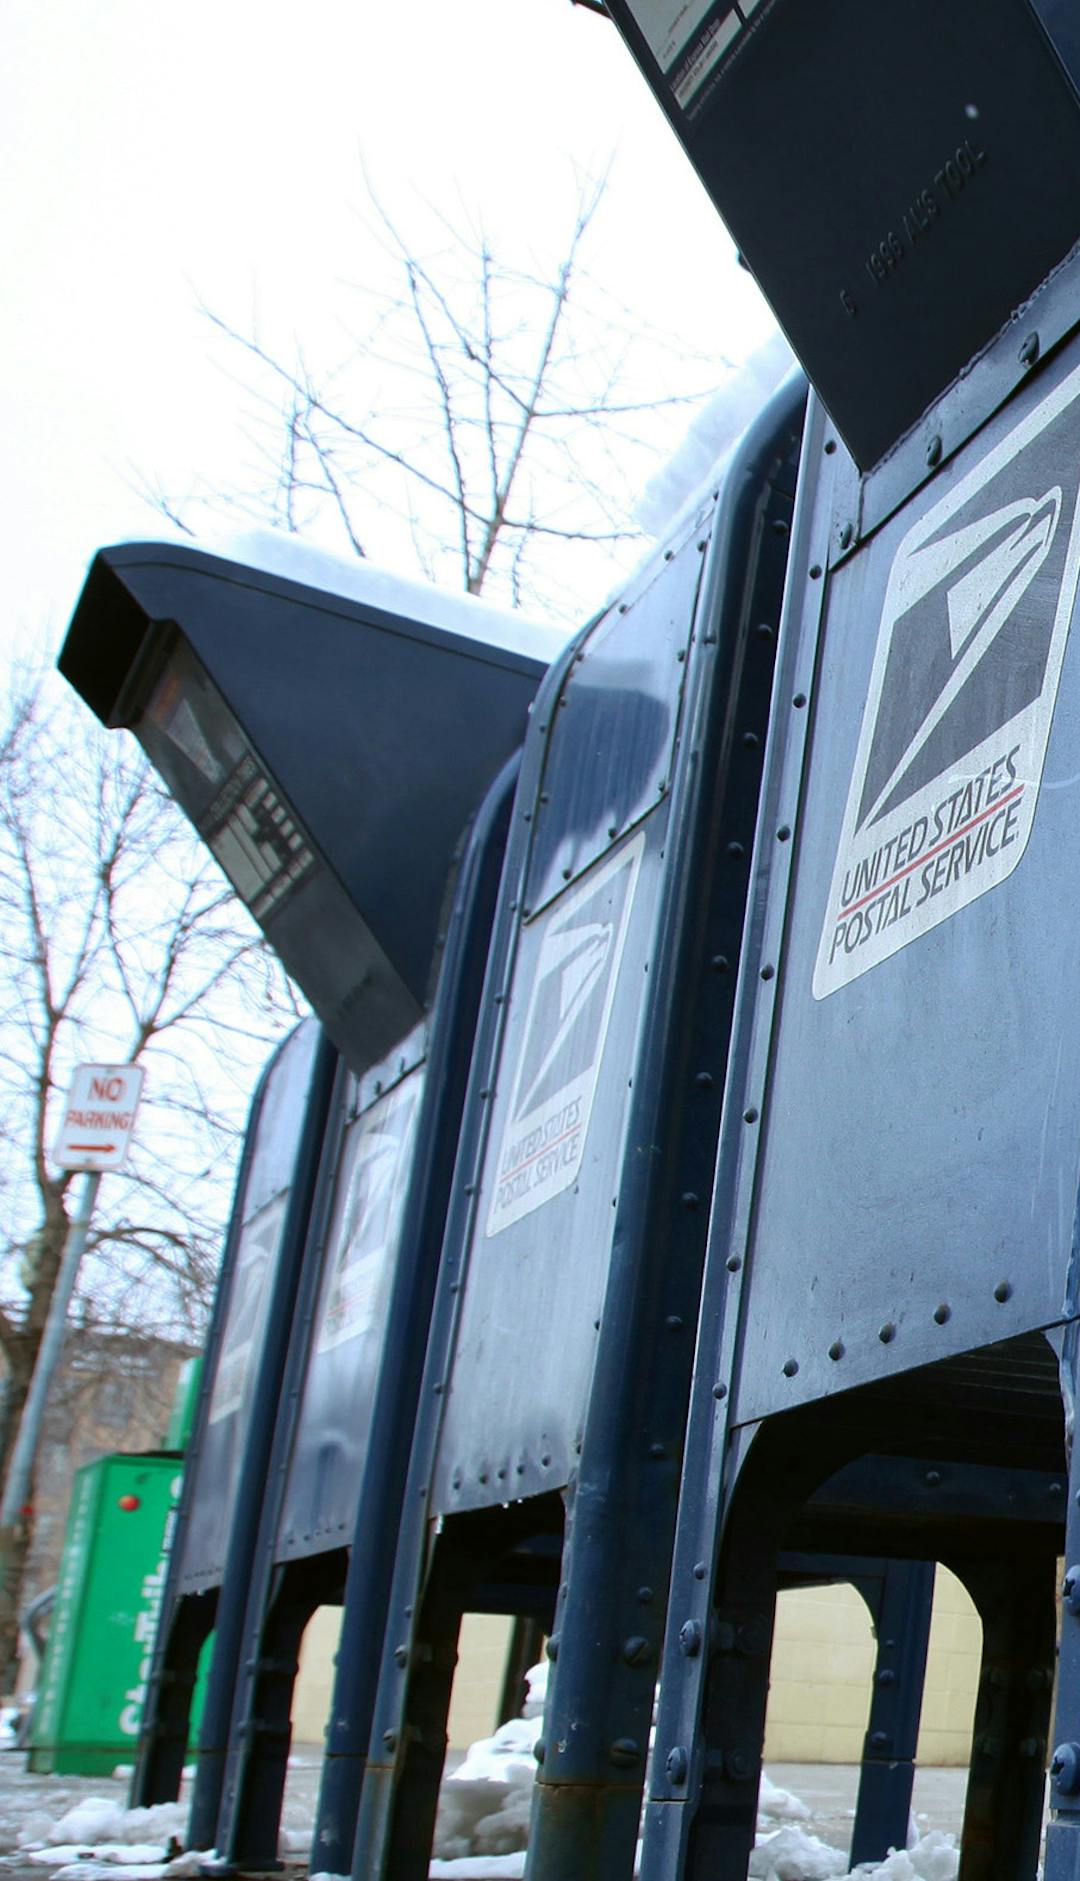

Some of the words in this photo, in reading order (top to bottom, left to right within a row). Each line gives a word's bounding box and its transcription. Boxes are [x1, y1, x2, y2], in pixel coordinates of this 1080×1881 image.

[933, 139, 991, 201] TOOL
[840, 815, 929, 907] UNITED
[928, 744, 1020, 847] STATES
[829, 877, 912, 965] POSTAL
[916, 797, 1023, 908] SERVICE
[87, 1075, 127, 1102] NO
[65, 1109, 132, 1131] PARKING
